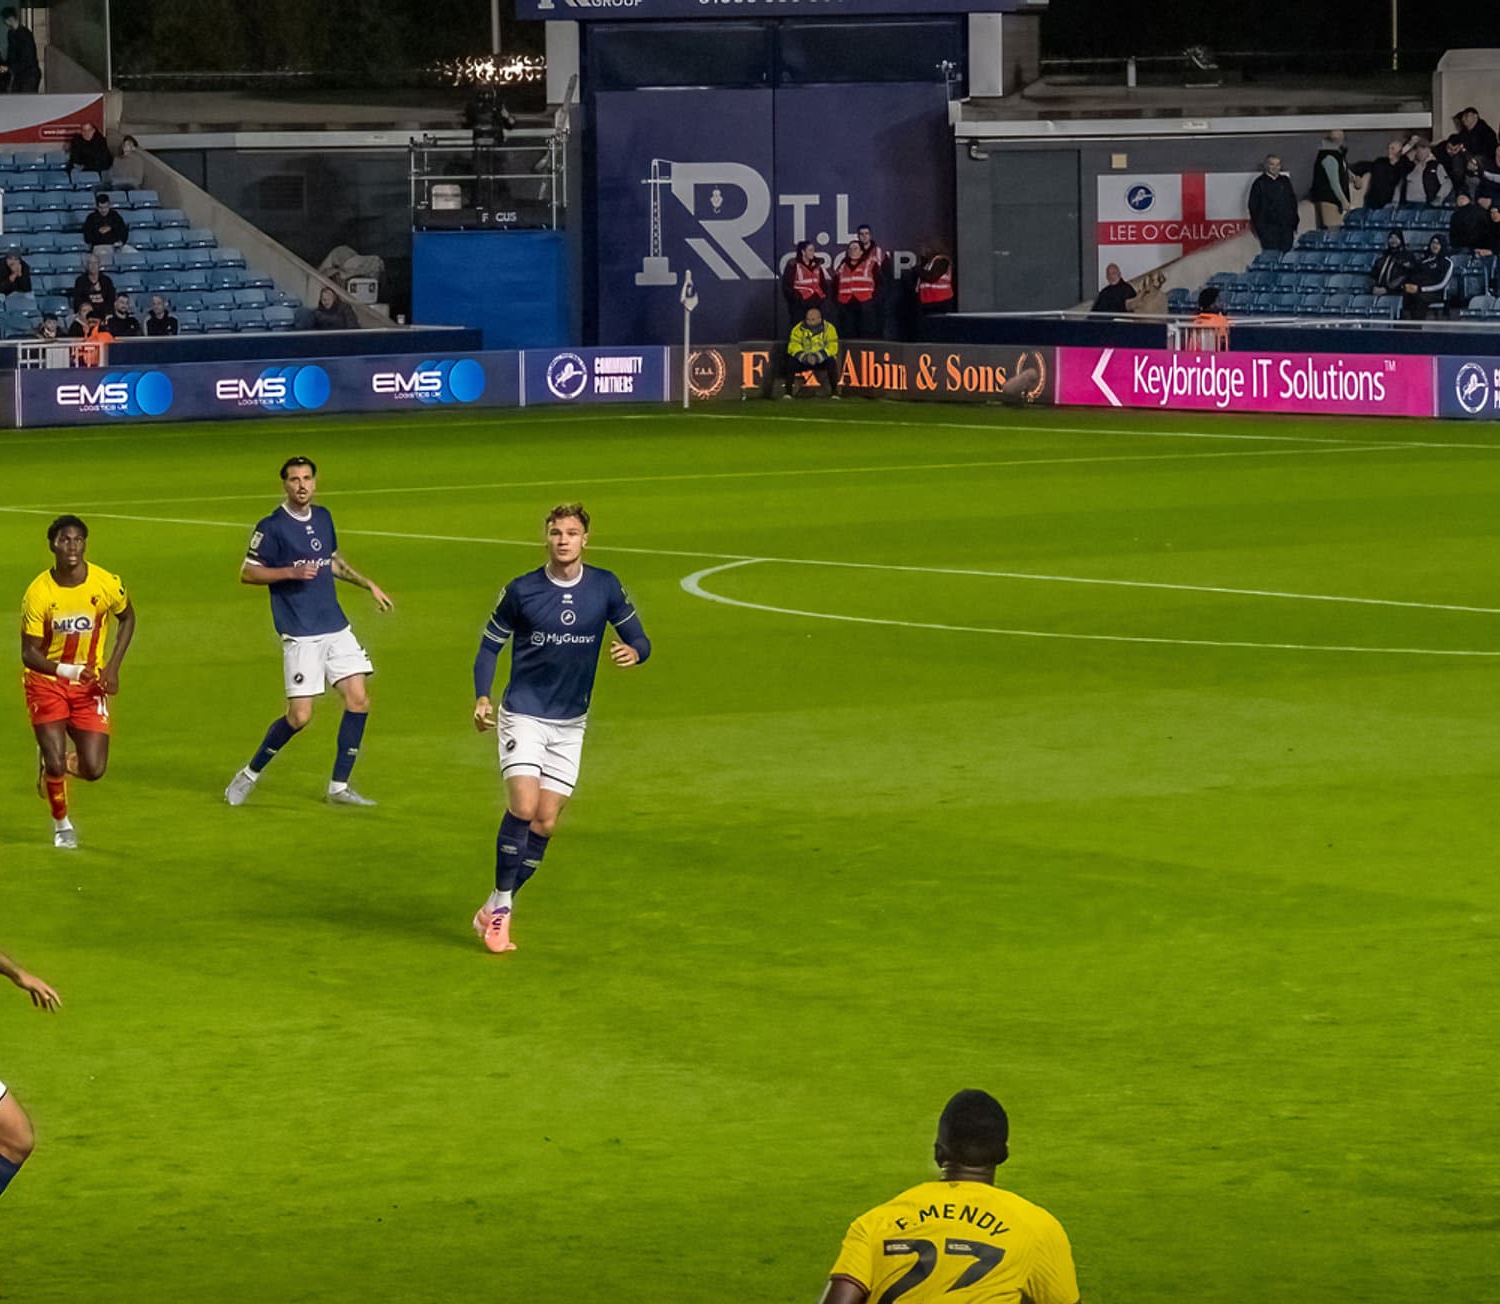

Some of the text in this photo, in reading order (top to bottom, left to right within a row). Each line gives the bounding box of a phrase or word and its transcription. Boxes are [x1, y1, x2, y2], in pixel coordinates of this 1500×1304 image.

[1109, 225, 1137, 241] LEE
[594, 356, 643, 374] COMMUNITY
[837, 349, 908, 391] Albin
[916, 353, 938, 391] &
[946, 354, 1006, 393] Sons
[215, 377, 286, 400] EMS
[372, 371, 443, 393] EMS
[594, 376, 634, 394] PARTNERS
[1133, 354, 1244, 407] Keybridge
[1252, 358, 1272, 398] IT
[56, 383, 128, 405] EMS
[53, 616, 92, 631] MrQ
[876, 1237, 1006, 1304] 27
